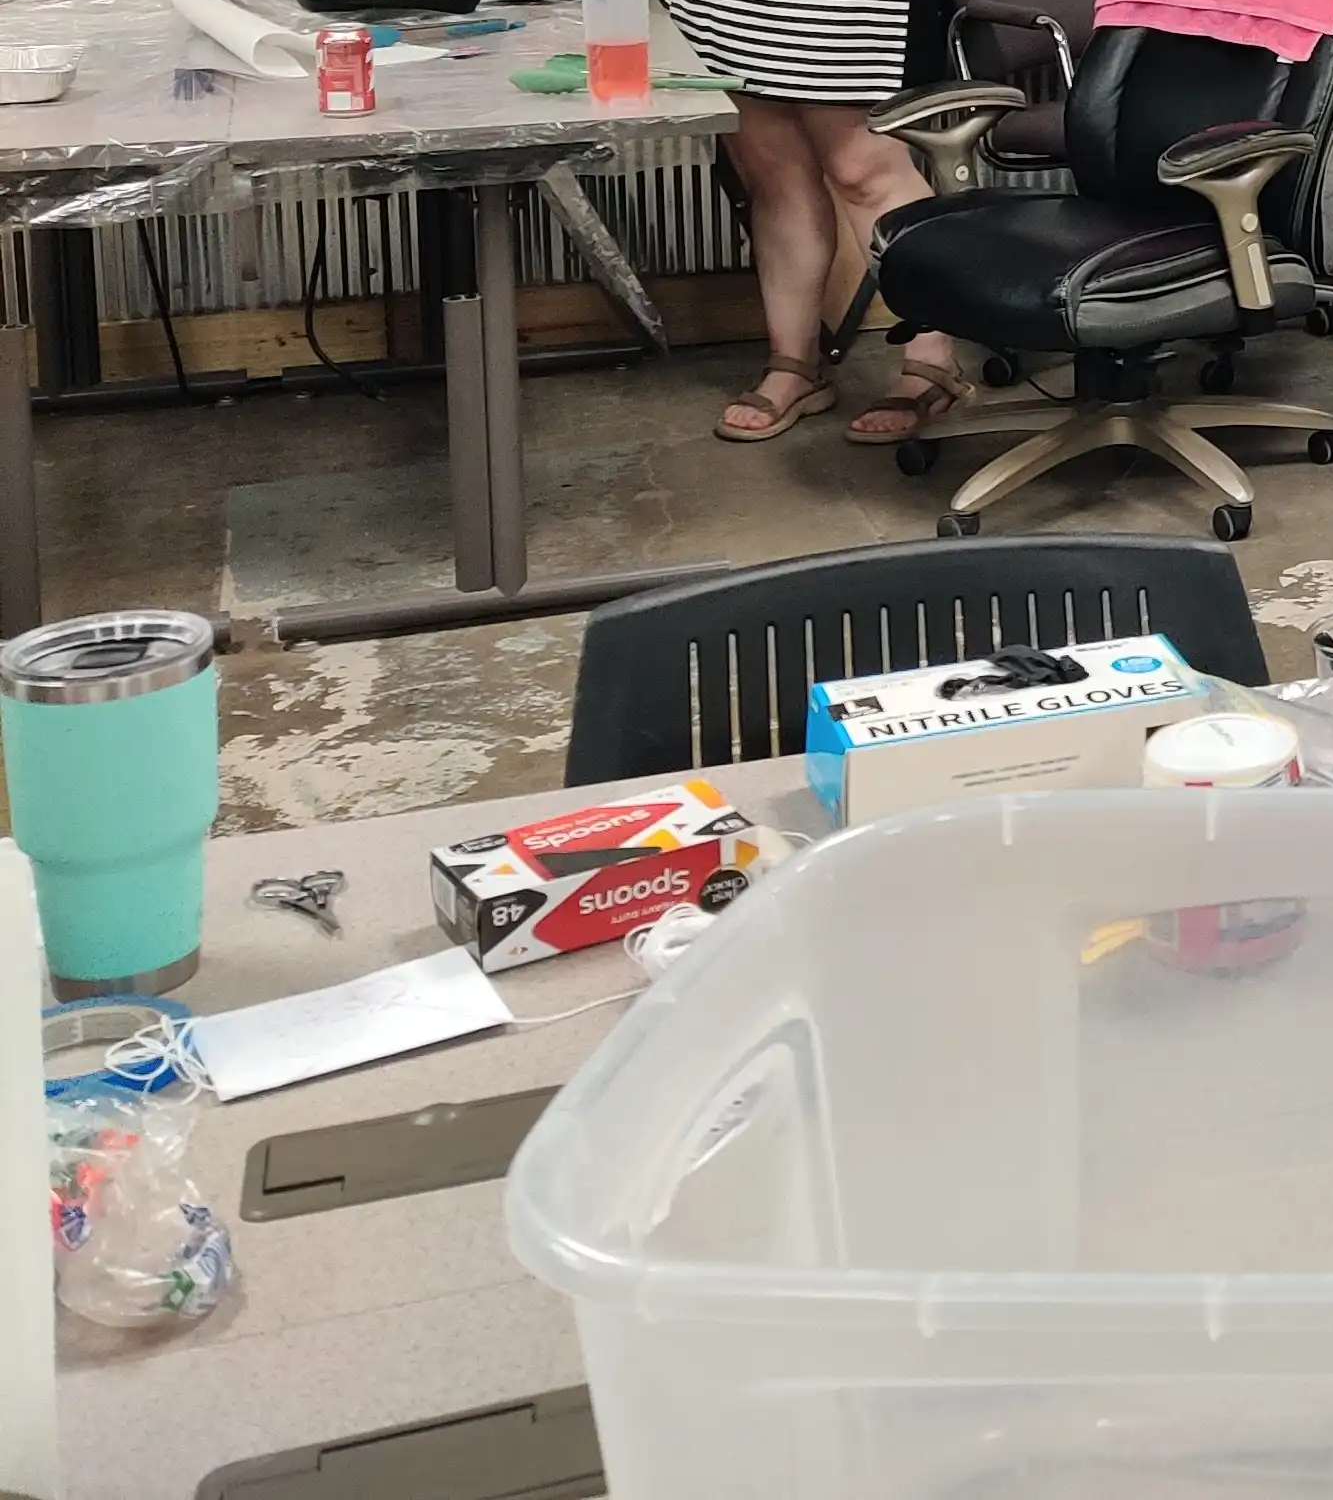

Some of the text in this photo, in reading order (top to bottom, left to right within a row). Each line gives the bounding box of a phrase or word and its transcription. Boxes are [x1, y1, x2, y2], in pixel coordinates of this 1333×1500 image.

[868, 701, 1025, 739] NITRILE
[1036, 680, 1185, 712] GLOVES
[523, 807, 652, 851] Spoons
[578, 867, 691, 916] Spoons
[491, 903, 527, 927] 48
